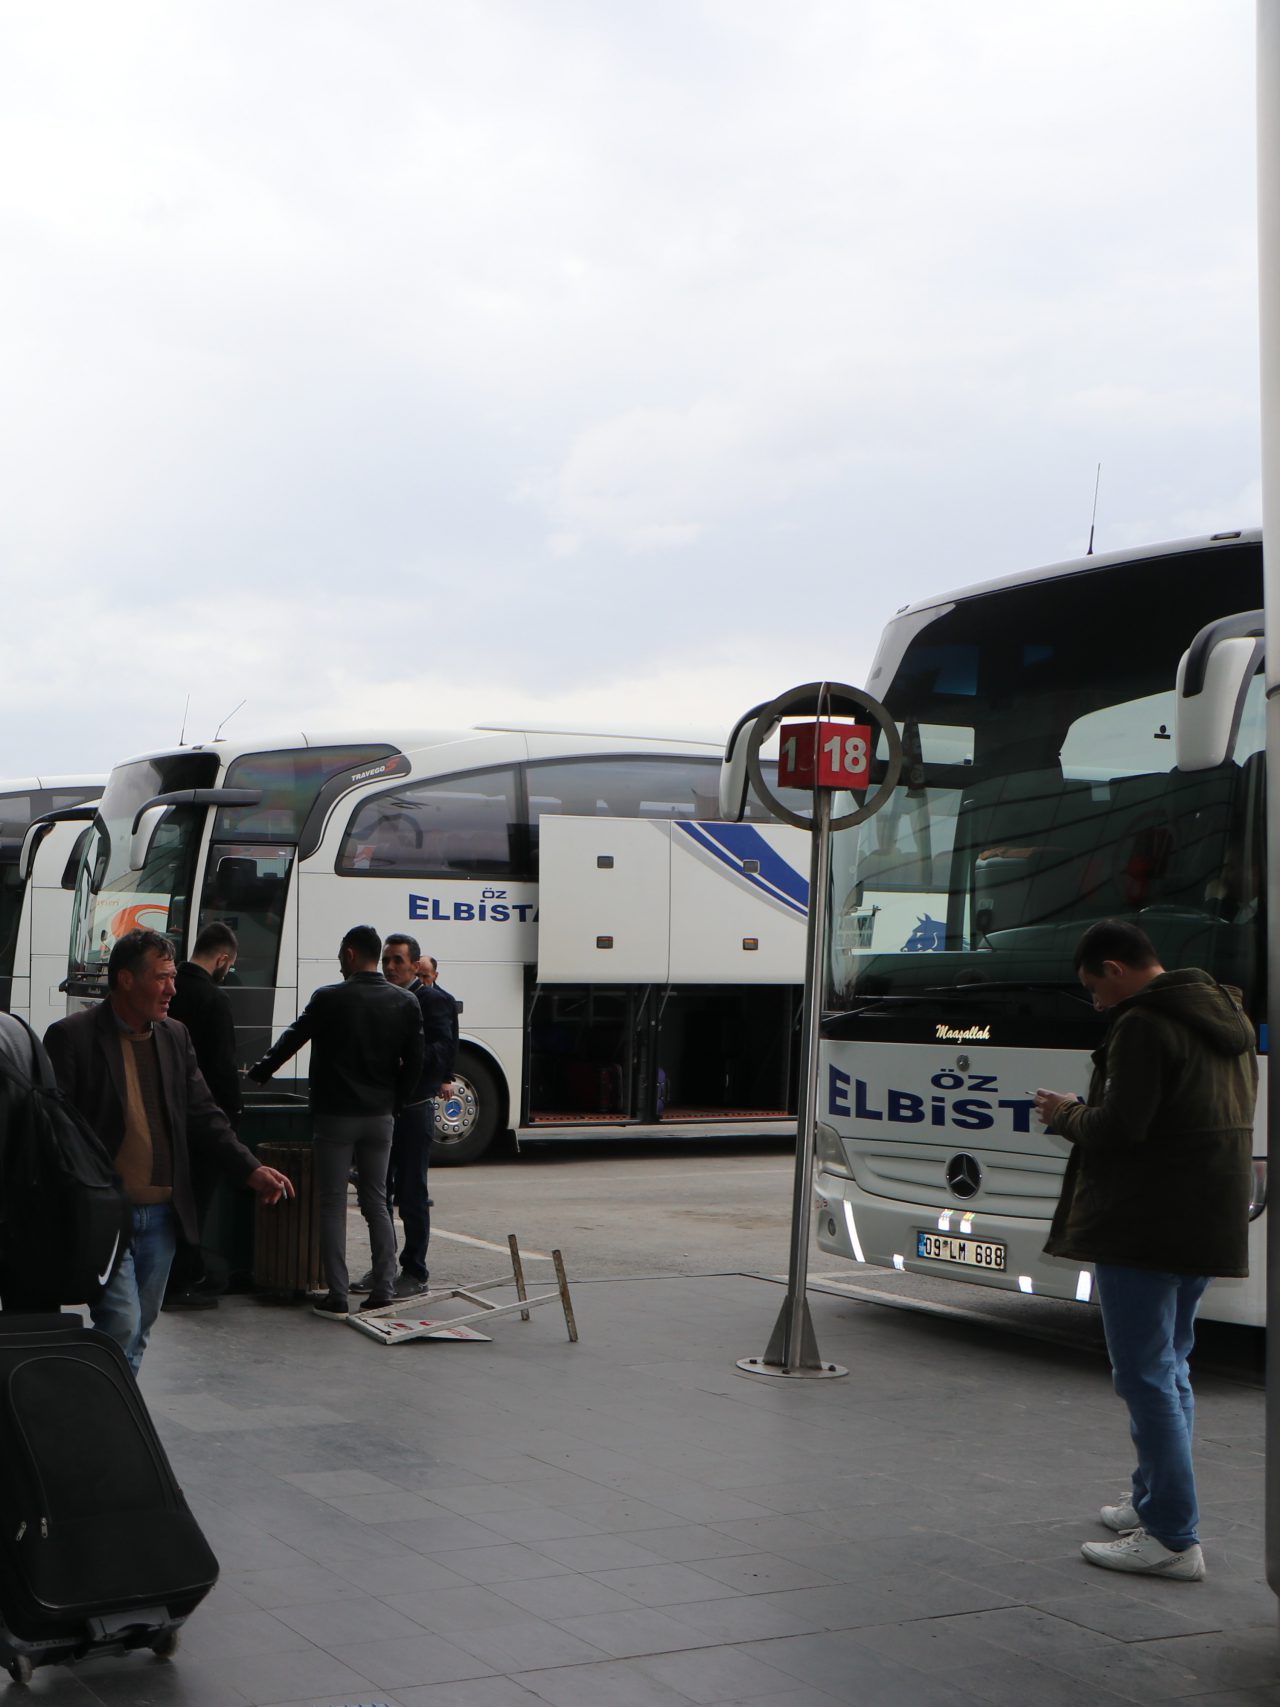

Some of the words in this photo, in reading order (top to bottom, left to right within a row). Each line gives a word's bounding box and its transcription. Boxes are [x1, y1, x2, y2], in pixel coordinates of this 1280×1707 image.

[824, 735, 867, 774] 18
[351, 765, 386, 782] TRAVEGO
[482, 887, 507, 899] ÖZ
[931, 1068, 999, 1093] ÖZ
[925, 1237, 941, 1257] 09
[949, 1240, 966, 1261] LM
[975, 1244, 1004, 1267] 688
